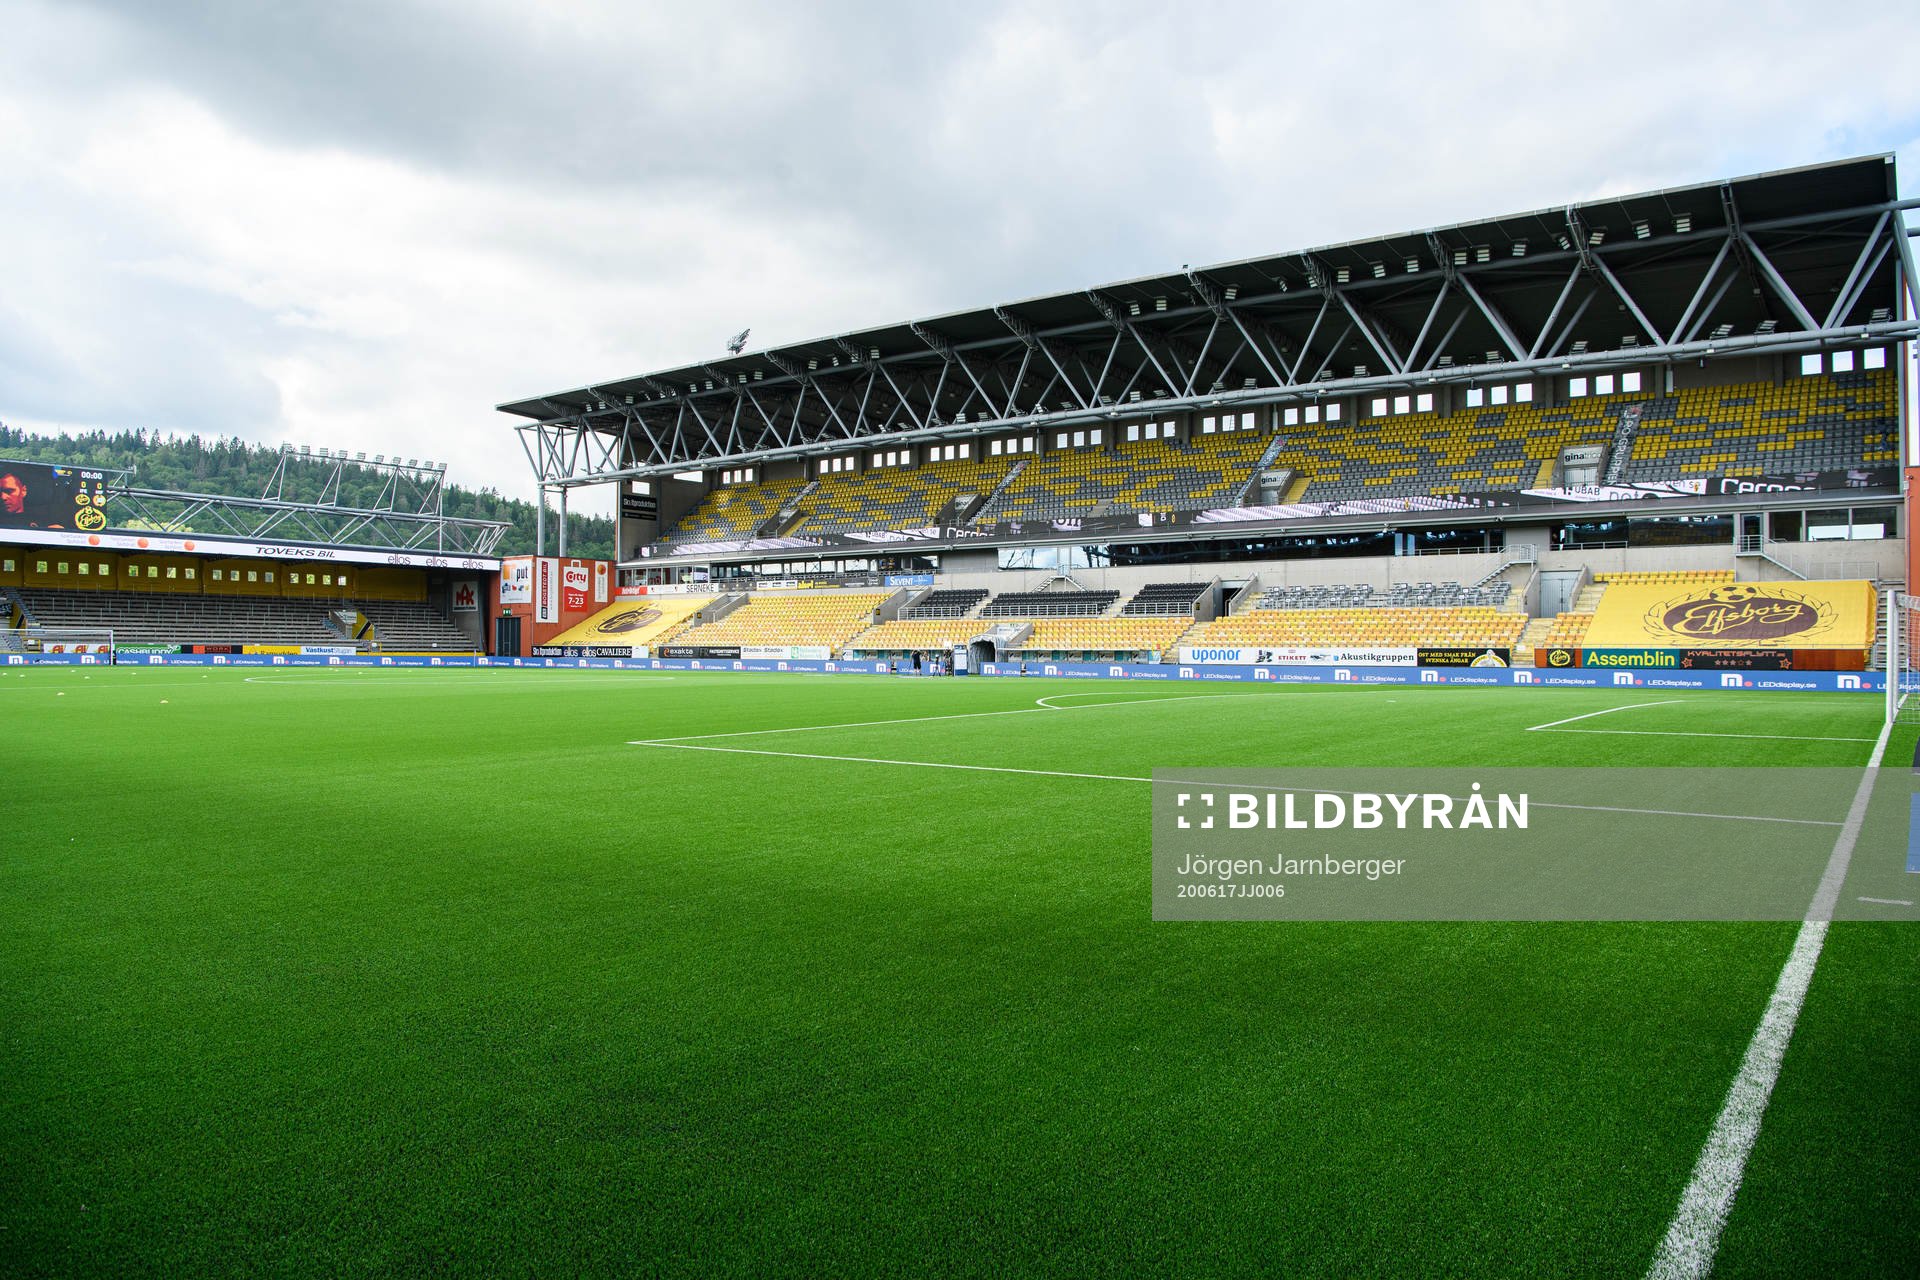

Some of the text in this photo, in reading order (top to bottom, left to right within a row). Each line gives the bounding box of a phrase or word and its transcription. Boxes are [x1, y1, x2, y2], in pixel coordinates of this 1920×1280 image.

[256, 547, 315, 557] TOVEKS
[686, 584, 714, 593] SERNEKE
[1673, 602, 1804, 636] Elfsborg
[1192, 649, 1240, 663] uponor
[1341, 653, 1414, 663] Akustikgruppen
[1587, 652, 1675, 666] Assemblin
